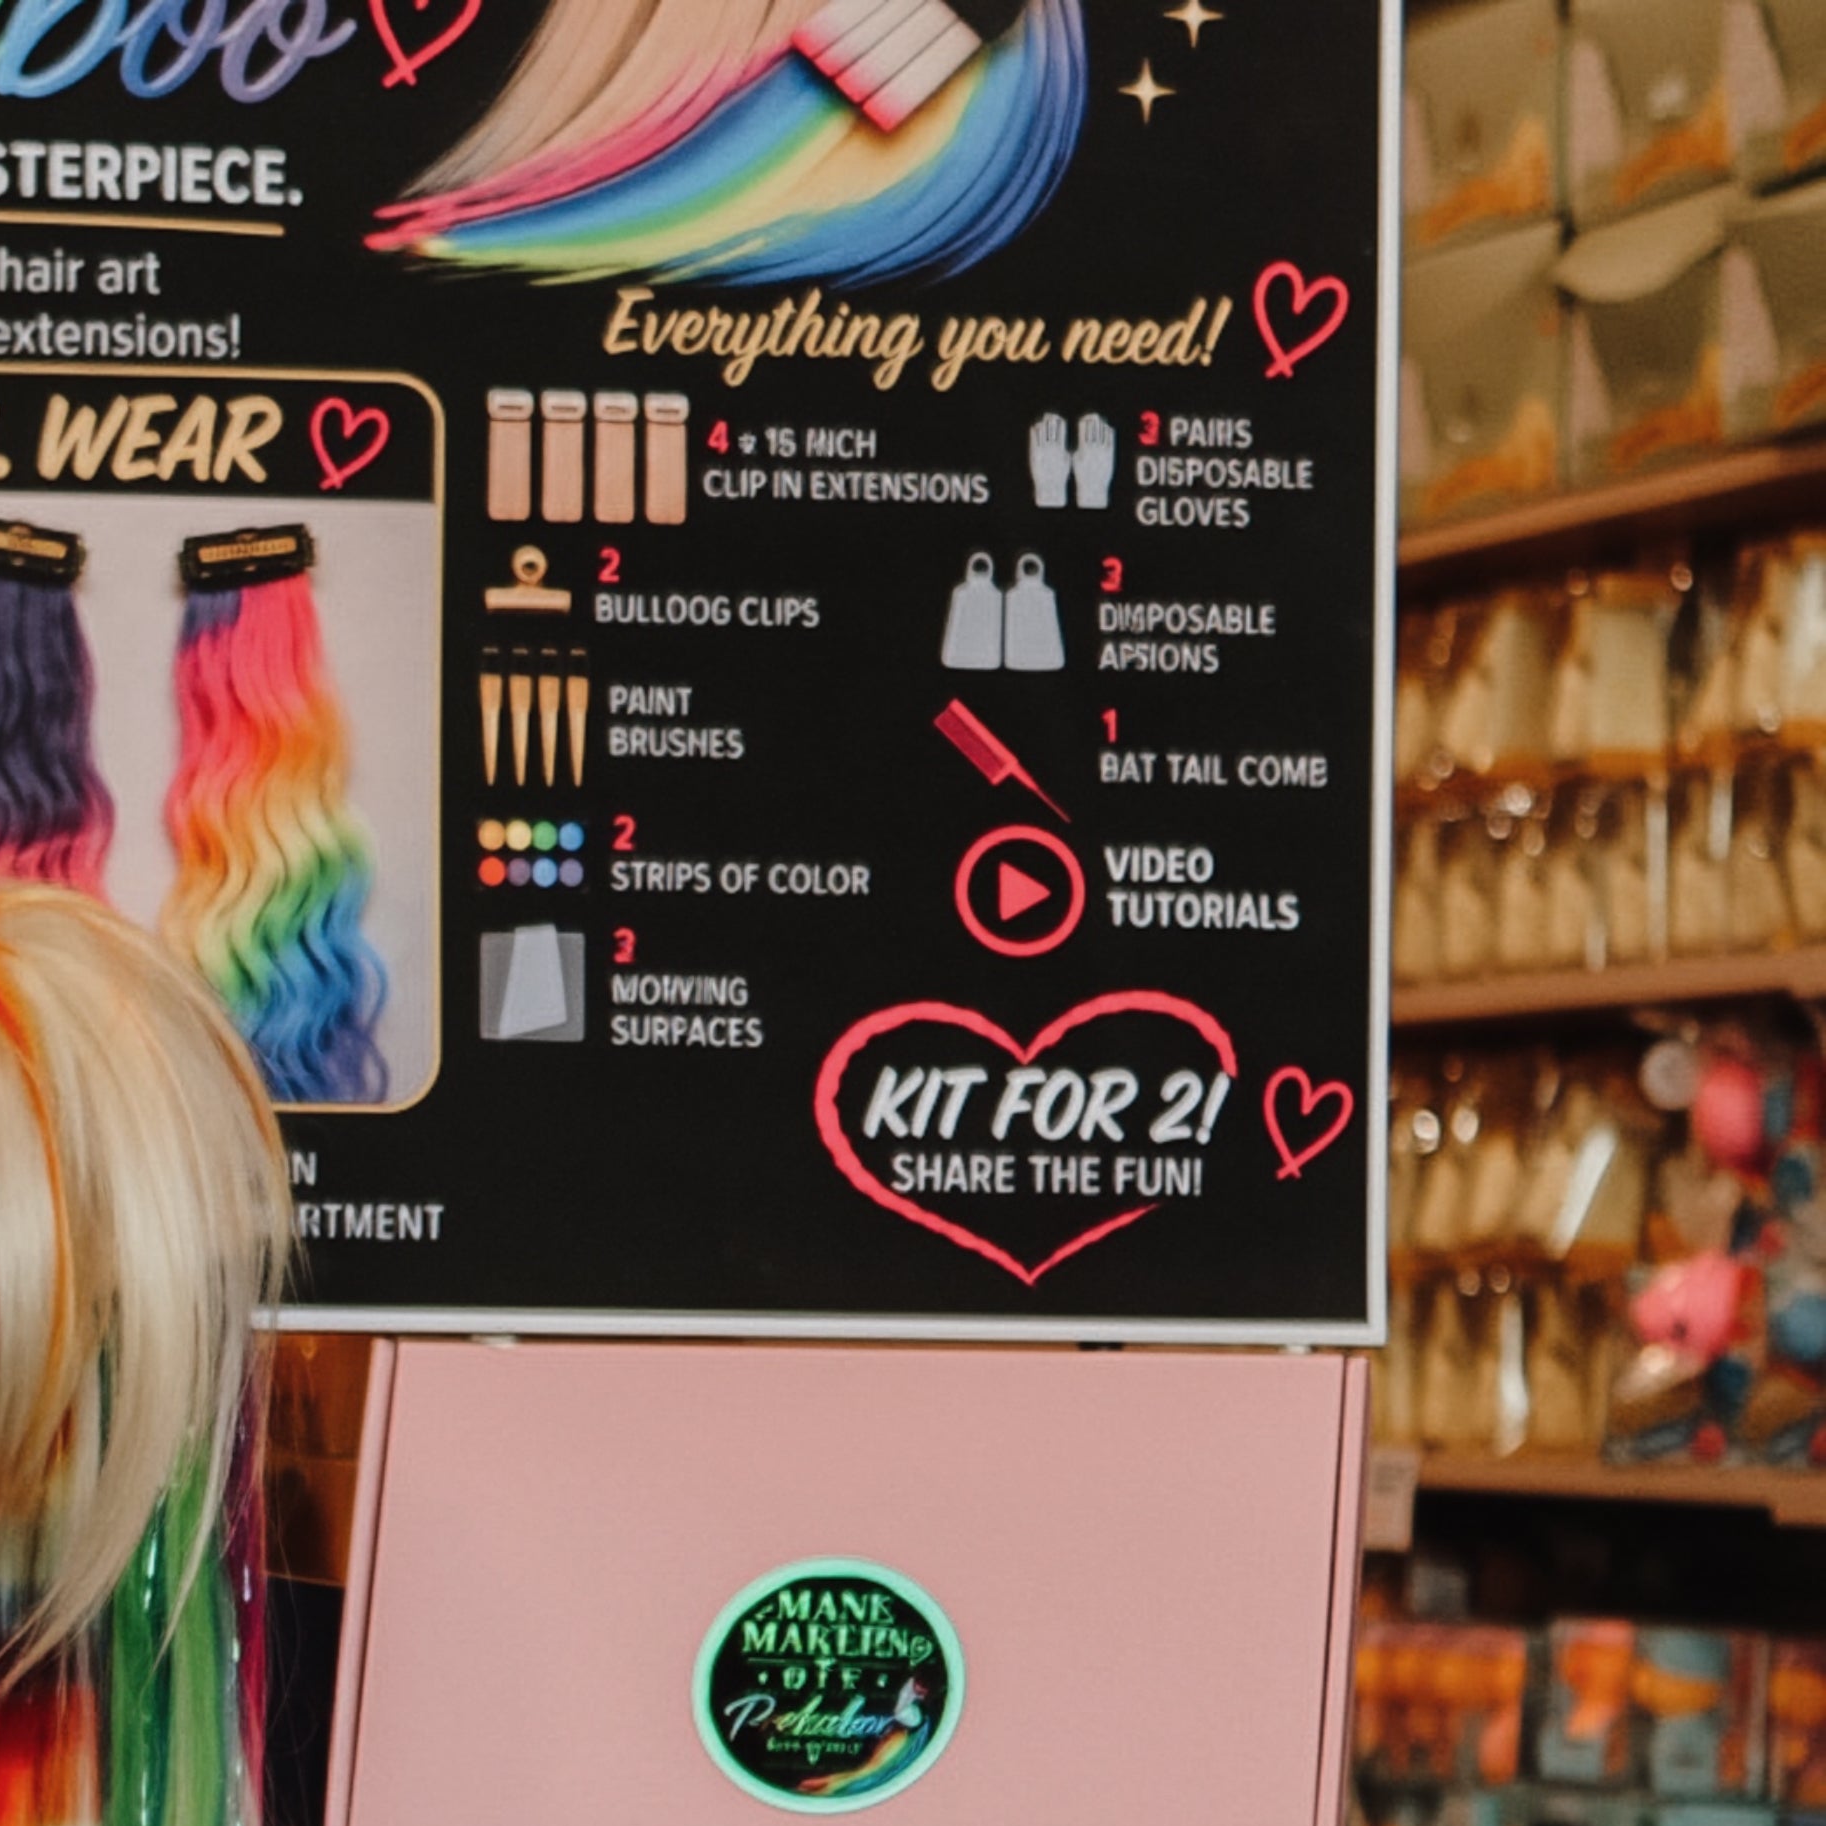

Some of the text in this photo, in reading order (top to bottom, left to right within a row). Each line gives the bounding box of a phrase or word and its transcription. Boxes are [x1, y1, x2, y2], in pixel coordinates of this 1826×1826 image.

[96, 251, 161, 296] art
[602, 287, 1234, 392] Everything you need!
[37, 393, 284, 483] WEAR
[707, 419, 730, 454] 4
[702, 468, 991, 504] CLIP IN EXTENSIONS
[1136, 496, 1252, 529] GLOVES
[598, 547, 622, 584] 2
[738, 595, 821, 629] CLIPS
[608, 684, 693, 717] PAINT
[1101, 708, 1119, 744] 1
[1166, 753, 1229, 786] TAIL
[612, 814, 637, 852] 2
[610, 860, 870, 897] STRIPS OF COLOR
[1104, 846, 1215, 885] VIDEO
[1106, 891, 1301, 931] TUTORIALS
[863, 1064, 1231, 1146] KIT FOR 2!
[890, 1152, 1204, 1197] SHARE THE FUN!
[295, 1202, 445, 1242] RTMENT
